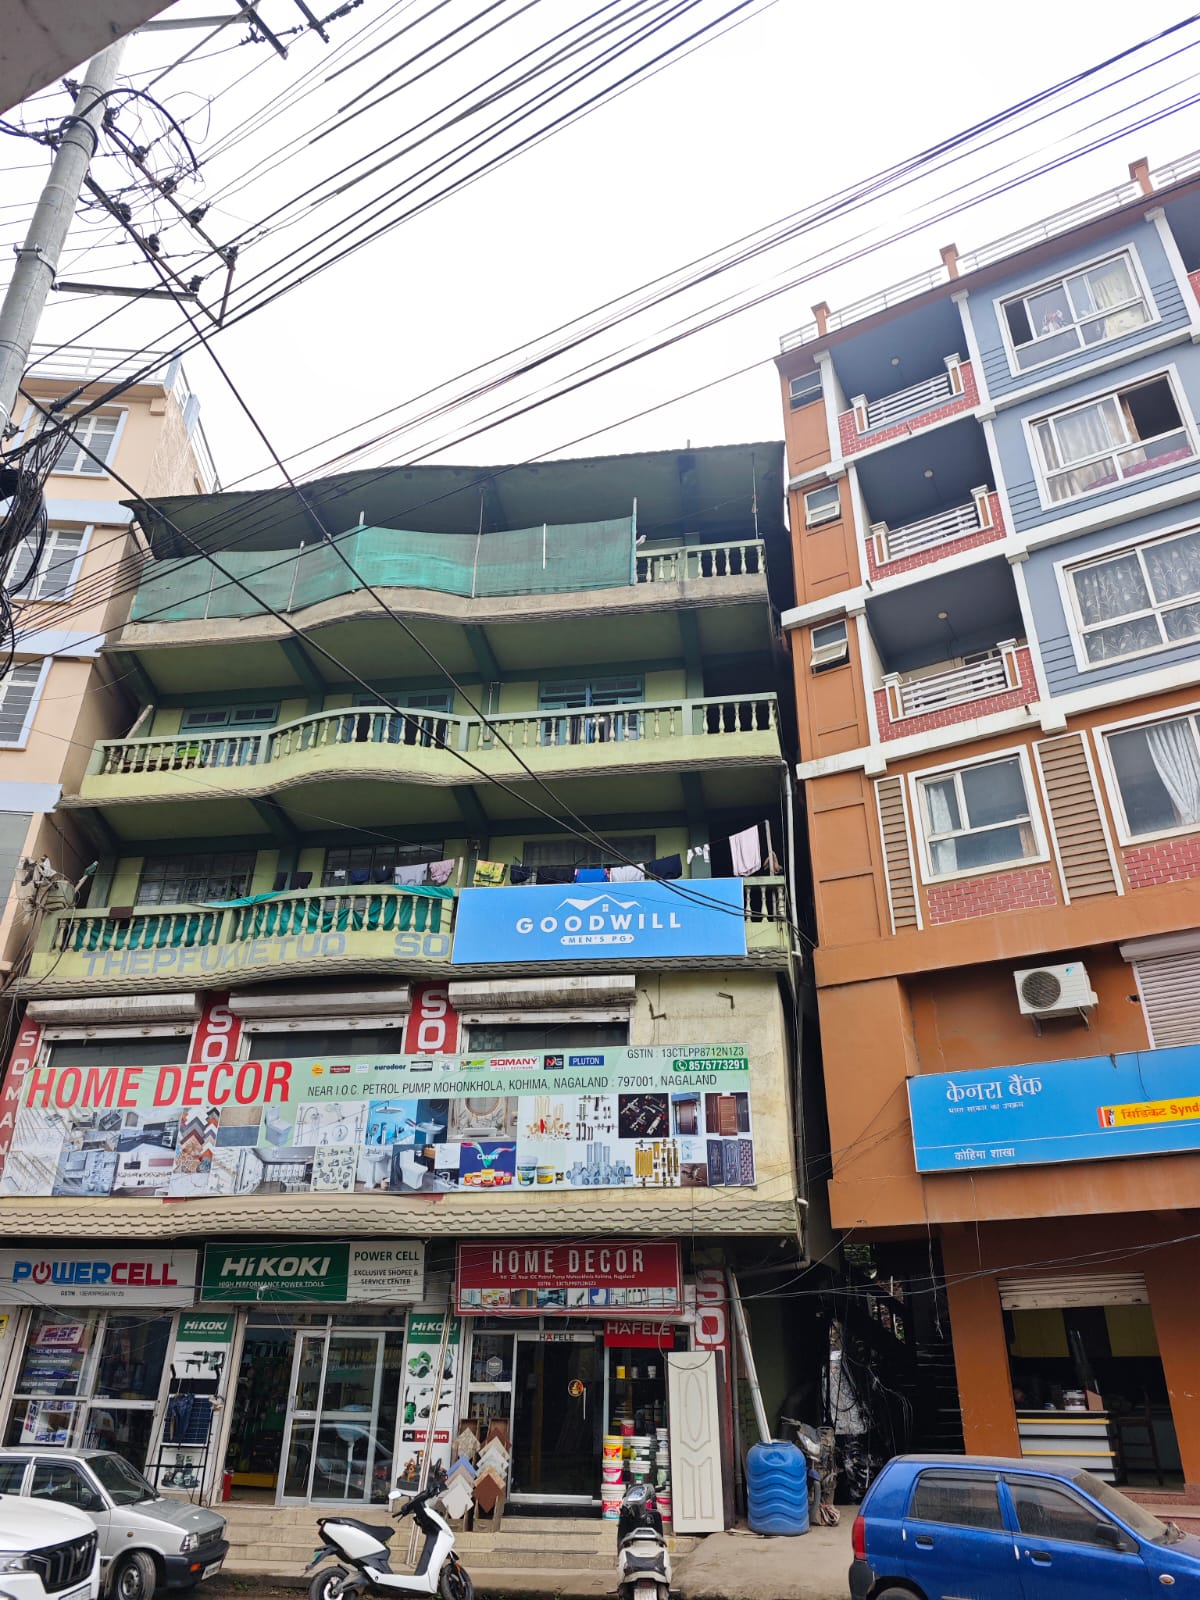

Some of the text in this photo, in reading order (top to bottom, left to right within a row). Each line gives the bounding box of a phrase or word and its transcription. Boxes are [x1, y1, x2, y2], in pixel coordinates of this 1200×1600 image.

[516, 912, 681, 934] GOODWILL
[627, 1049, 654, 1058] GSTIN
[490, 1058, 538, 1066] SOMANY
[572, 1056, 600, 1065] PLUTON
[688, 1060, 745, 1070] 8575773291
[25, 1060, 293, 1109] HOME DECOR
[308, 1086, 332, 1096] NEAR
[362, 1083, 400, 1094] PETROL
[402, 1082, 430, 1094] PUMP,
[433, 1080, 506, 1094] MOHONKHOLA,
[508, 1078, 550, 1090] KOHIMA,
[554, 1076, 608, 1088] NAGALAND
[618, 1076, 658, 1088] 797001,
[660, 1074, 717, 1086] NAGALAND
[946, 1074, 1042, 1102] केनरा बैंक
[1170, 1102, 1200, 1116] Synd
[954, 1148, 1015, 1161] कोहिमा शाखा
[354, 1250, 421, 1262] POWER CELL
[492, 1249, 644, 1274] HOME DECOR
[220, 1257, 331, 1276] HiKOKI
[184, 1320, 228, 1330] HiKOKI
[412, 1322, 458, 1332] HiKOI
